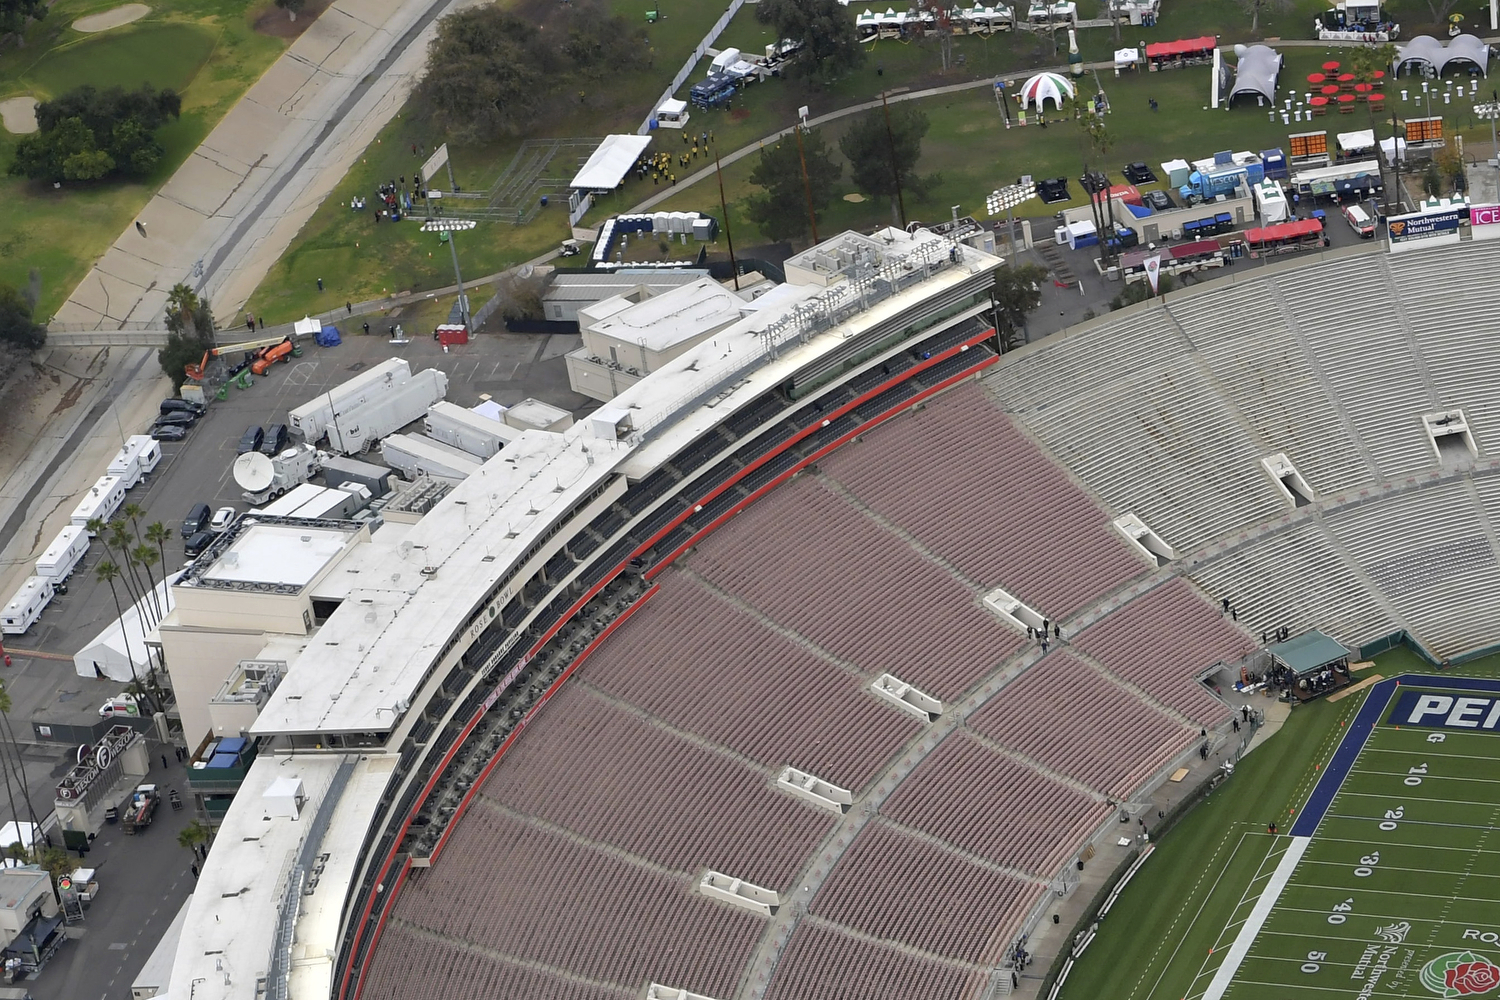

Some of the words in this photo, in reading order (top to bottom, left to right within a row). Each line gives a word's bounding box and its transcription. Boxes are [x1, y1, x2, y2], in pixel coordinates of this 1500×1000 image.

[1407, 214, 1458, 226] Northwestern
[1408, 223, 1435, 234] Mutual
[1475, 210, 1500, 224] ICE
[470, 615, 488, 638] ROSE
[496, 586, 513, 609] BOWL
[1426, 733, 1445, 744] G
[76, 767, 99, 794] WESCOM
[110, 730, 134, 758] WESCOM
[1403, 765, 1428, 786] 10
[1379, 808, 1405, 832] 20
[1354, 853, 1380, 877] 30
[1327, 899, 1353, 925] 40
[1300, 950, 1327, 974] 50
[1351, 944, 1382, 980] Mutual
[1396, 948, 1415, 979] presented
